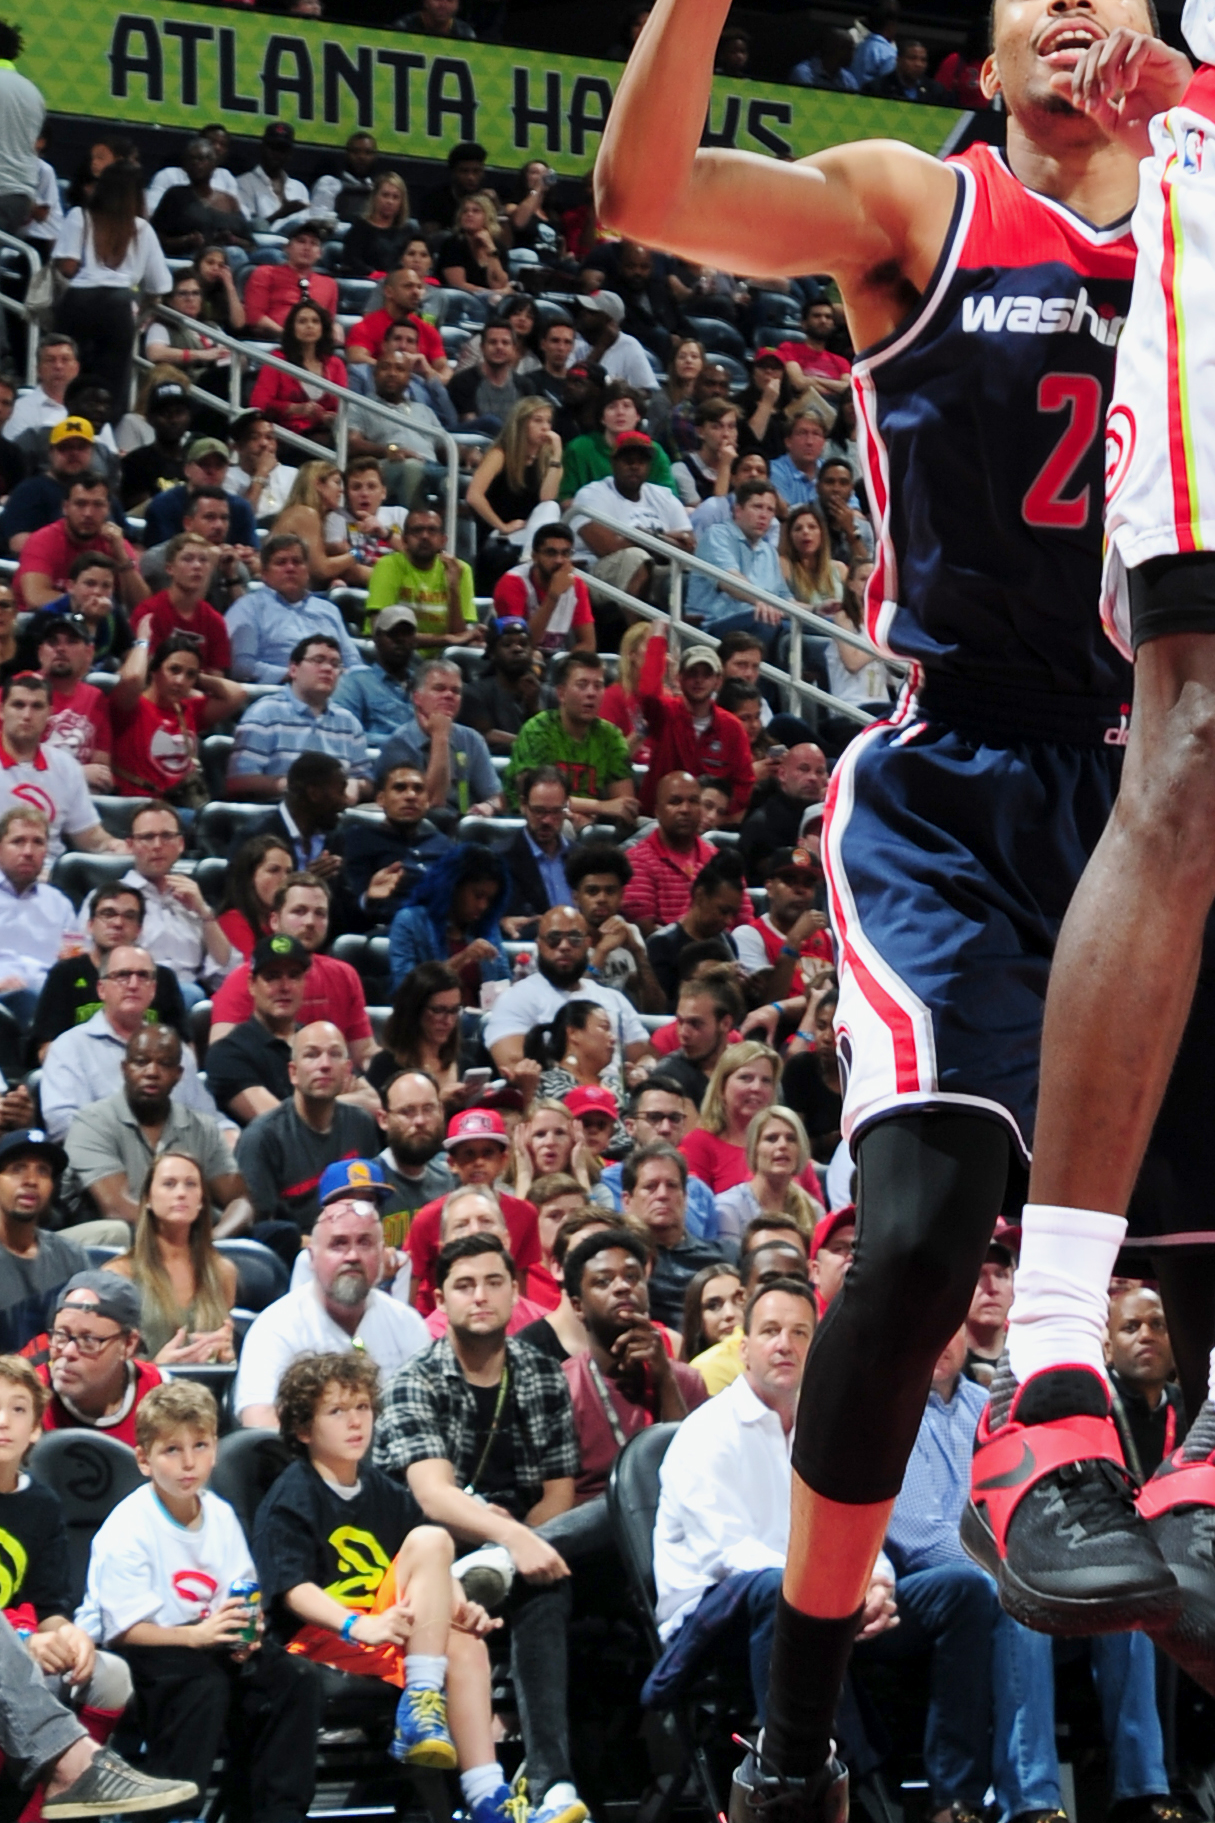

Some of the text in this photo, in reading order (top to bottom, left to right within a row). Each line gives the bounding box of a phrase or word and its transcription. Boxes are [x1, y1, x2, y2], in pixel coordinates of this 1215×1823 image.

[108, 13, 792, 158] ATLANTA HAS
[1022, 372, 1101, 529] 2
